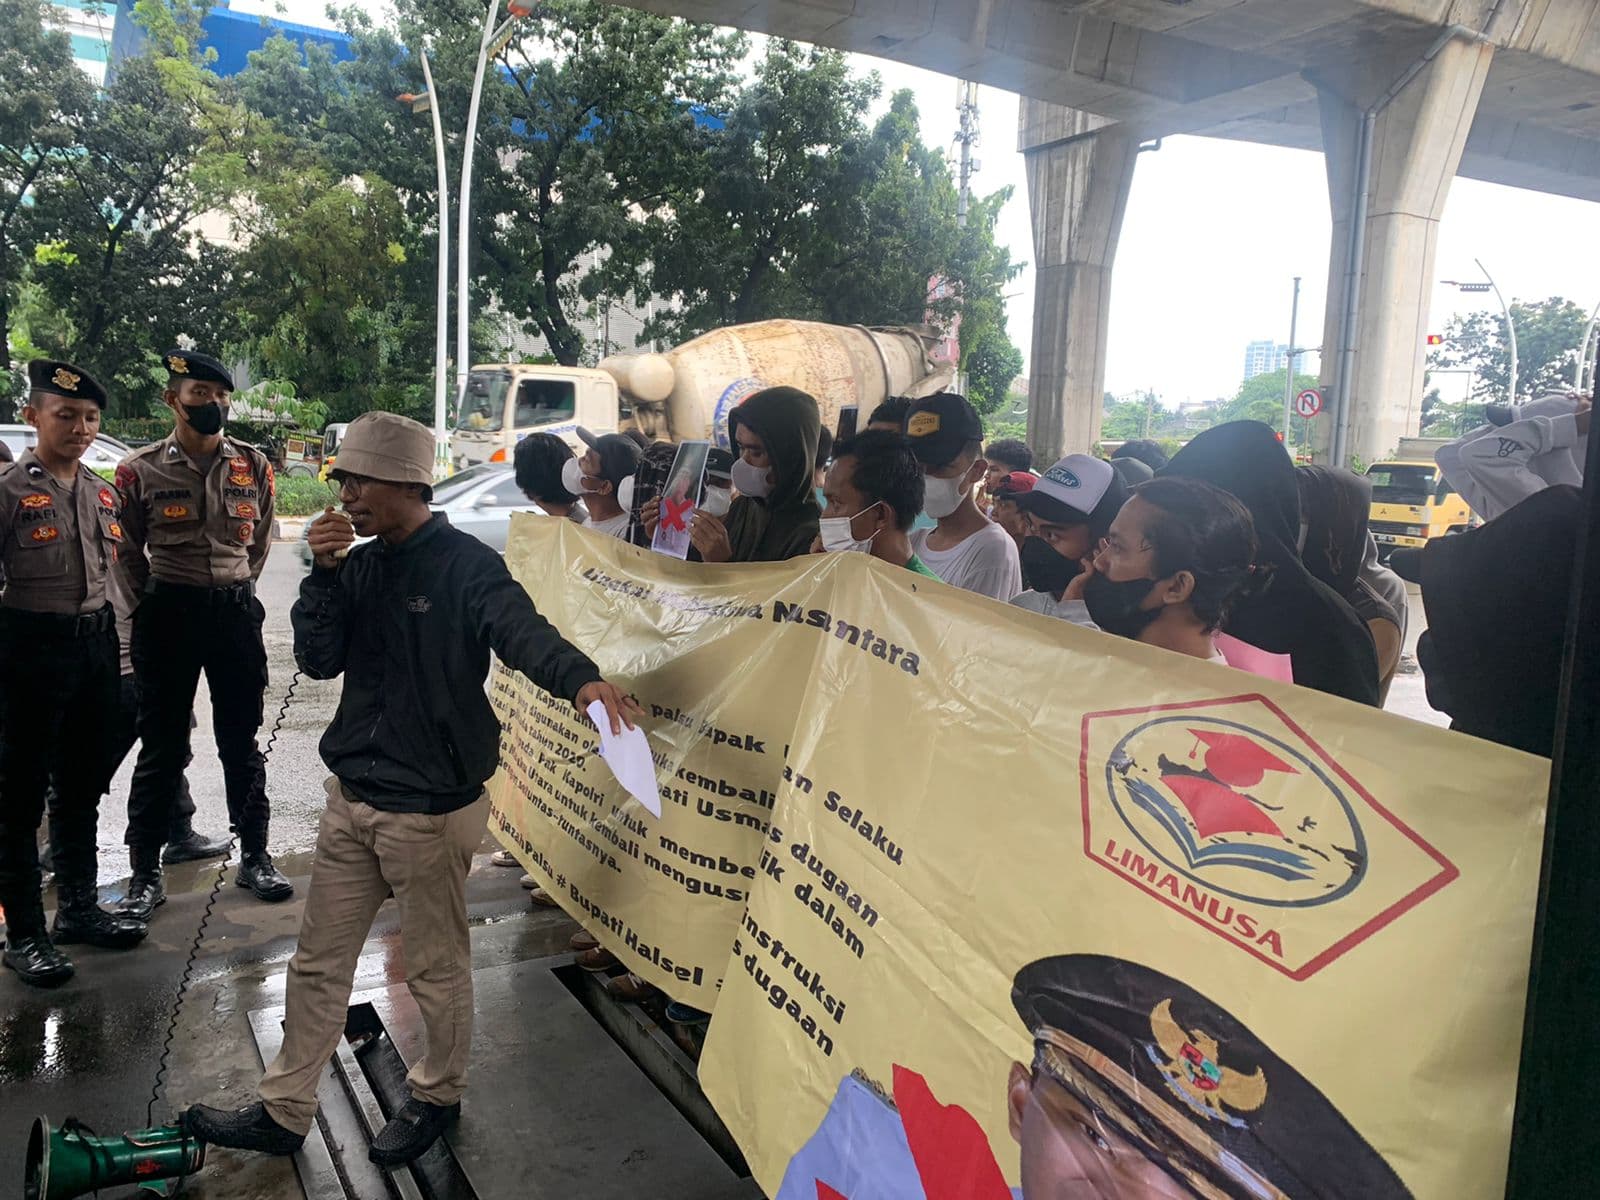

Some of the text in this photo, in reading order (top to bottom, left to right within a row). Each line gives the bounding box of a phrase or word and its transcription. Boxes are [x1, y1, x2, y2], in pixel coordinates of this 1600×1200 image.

[529, 725, 554, 751] tahun
[554, 742, 587, 772] 2020.
[651, 703, 694, 729] palsu
[823, 790, 904, 866] Selaku
[528, 766, 553, 796] Utara
[554, 789, 588, 821] untuk
[590, 811, 640, 860] kembali
[744, 954, 834, 1056] dugaan
[529, 704, 579, 745] digunakan
[794, 883, 865, 959] dalam
[562, 768, 605, 807] Kapolri
[611, 804, 648, 839] untuk
[741, 907, 846, 1024] instruksi
[675, 766, 776, 810] kembali
[790, 843, 879, 927] dugaan
[1104, 839, 1284, 959] LIMANUSA
[525, 840, 554, 880] Palsu
[556, 874, 567, 889] #
[570, 883, 624, 937] Bupati
[625, 928, 704, 987] Halsel
